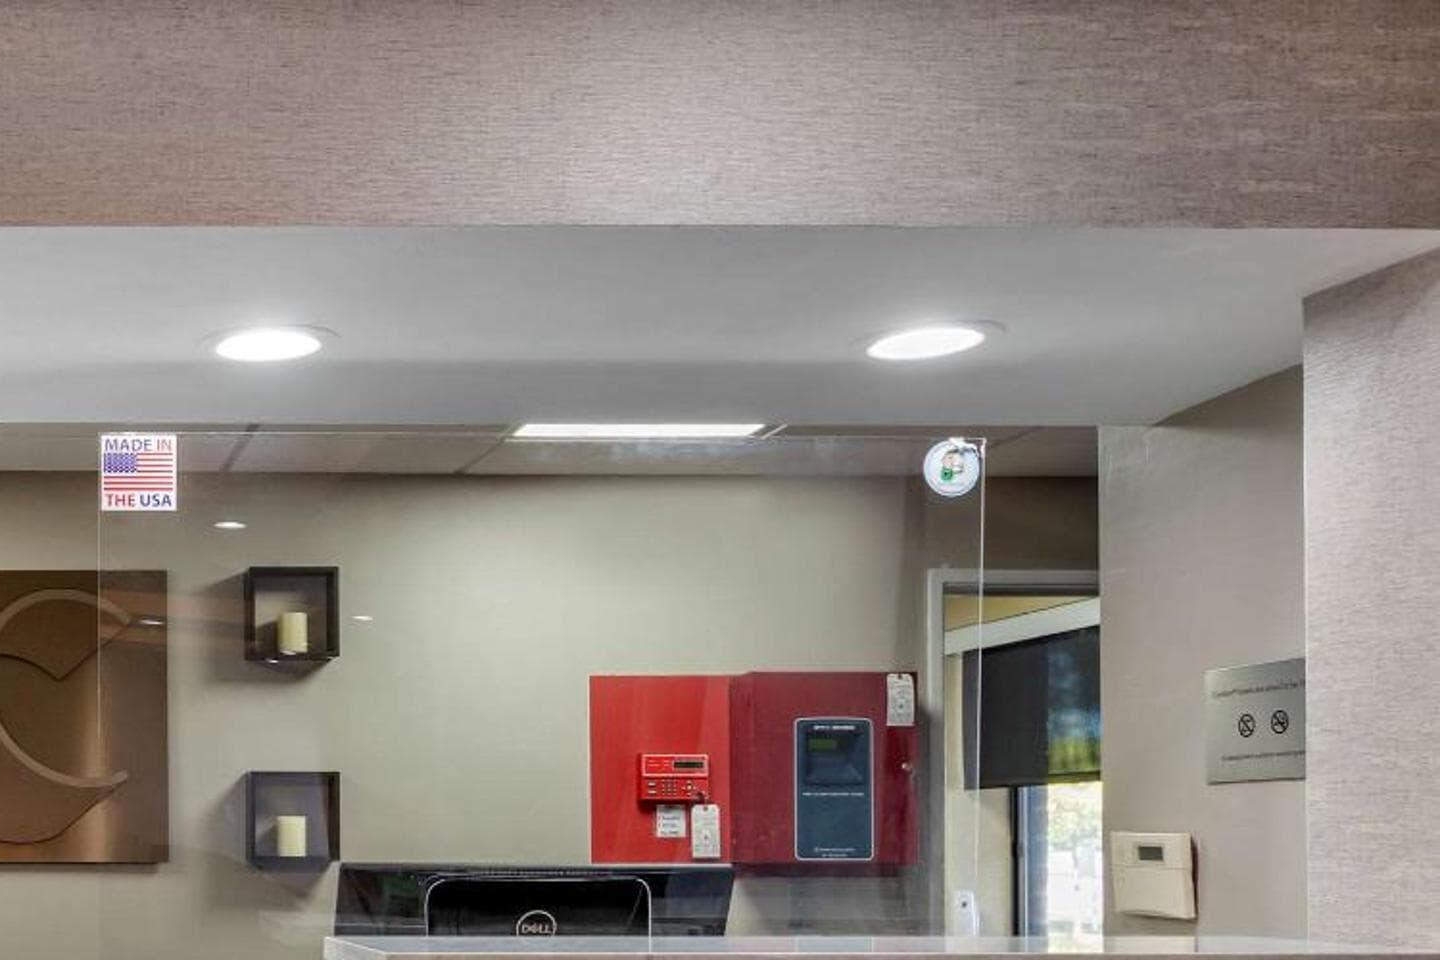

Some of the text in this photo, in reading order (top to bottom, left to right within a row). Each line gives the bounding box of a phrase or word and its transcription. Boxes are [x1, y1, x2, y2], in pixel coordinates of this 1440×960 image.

[105, 439, 172, 451] MADE IN
[105, 494, 172, 507] THE USA
[521, 923, 551, 934] DELL
